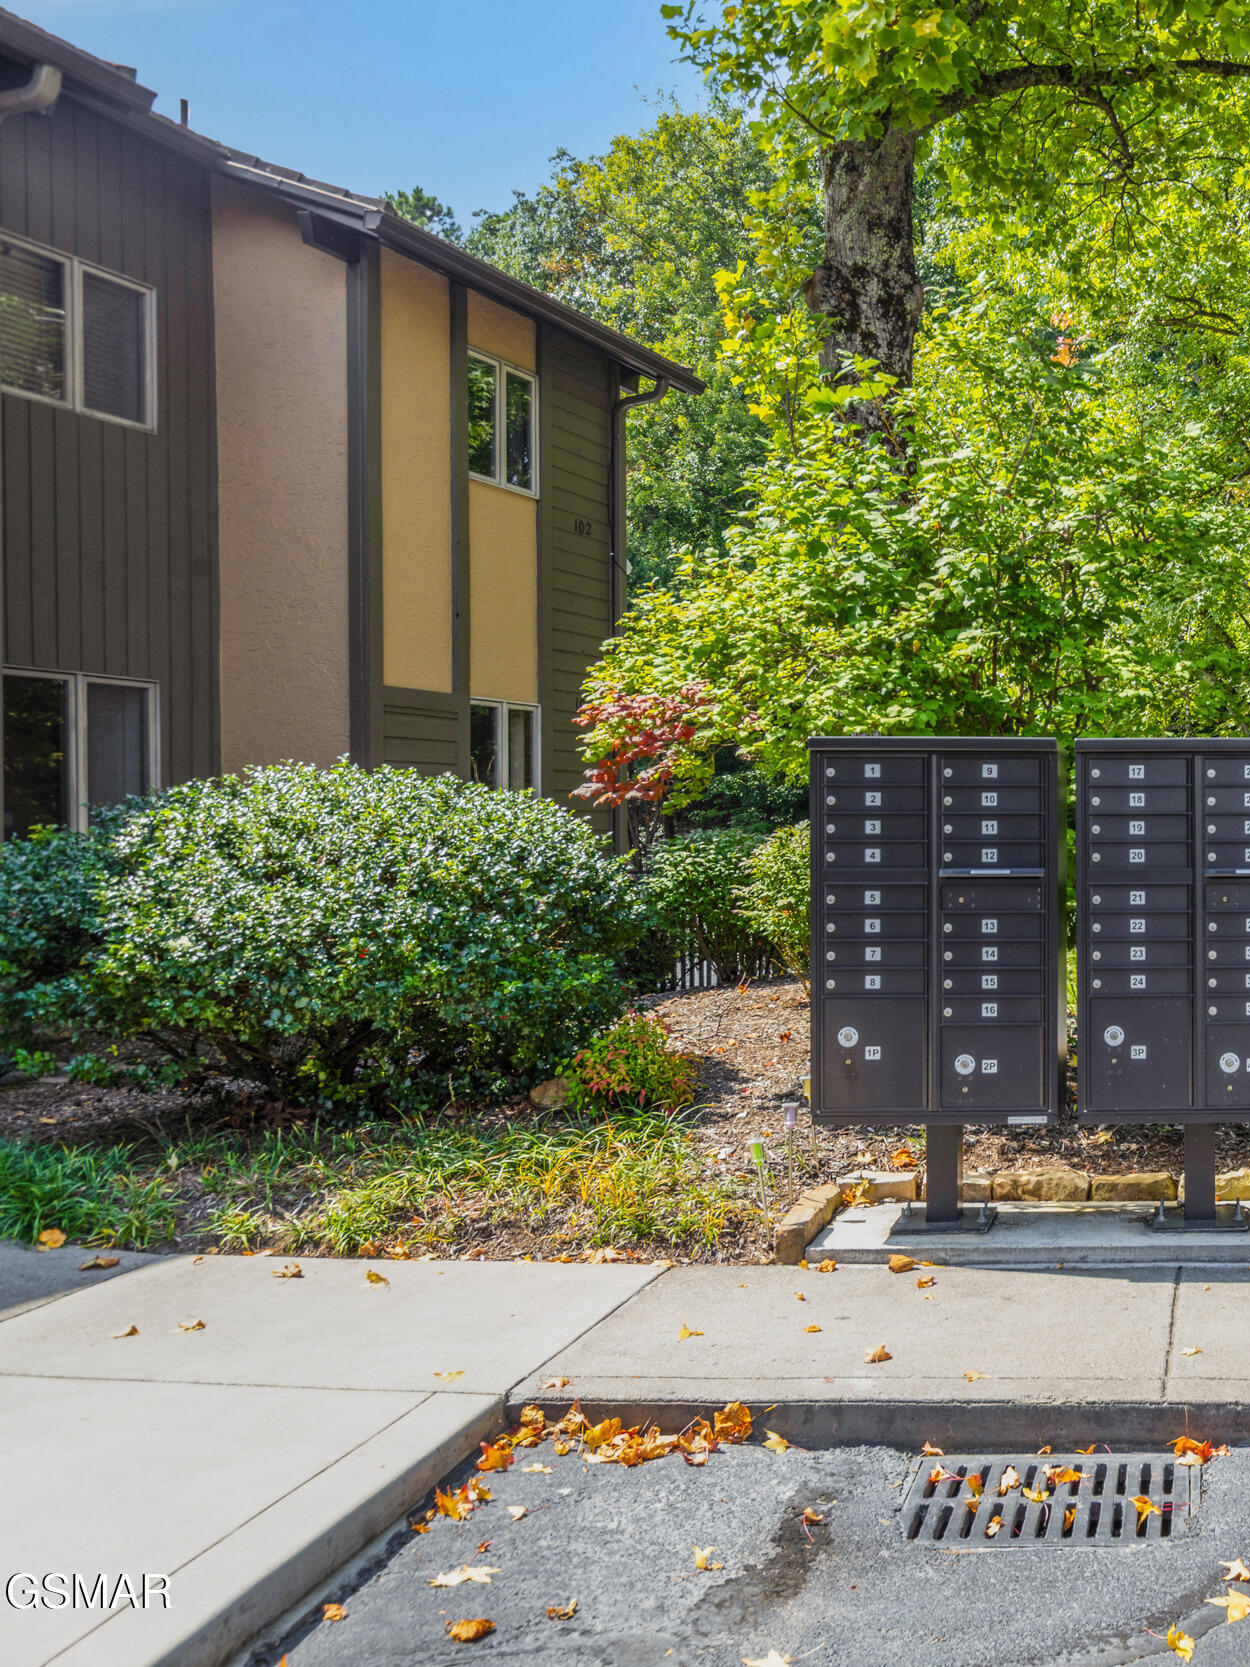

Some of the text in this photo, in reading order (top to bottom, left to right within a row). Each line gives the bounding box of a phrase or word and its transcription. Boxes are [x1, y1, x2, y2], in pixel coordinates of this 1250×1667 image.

[574, 518, 592, 535] 102
[870, 766, 875, 775] 1
[986, 766, 993, 776] 9
[1131, 767, 1142, 776] 17
[870, 794, 877, 804] 2
[984, 795, 996, 804] 10
[1131, 795, 1143, 804] 18
[870, 822, 877, 832] 3
[984, 823, 995, 832] 11
[1132, 823, 1143, 832] 19
[869, 851, 876, 860] 4
[984, 851, 996, 860] 12
[1131, 851, 1143, 860] 20
[869, 893, 876, 903] 5
[1131, 893, 1142, 902] 21
[869, 921, 876, 931] 6
[983, 921, 996, 931] 13
[1131, 921, 1143, 930] 22
[870, 949, 877, 959] 7
[984, 949, 996, 958] 14
[1132, 949, 1144, 958] 23
[869, 977, 876, 987] 8
[984, 977, 996, 987] 15
[1132, 977, 1144, 986] 24
[984, 1005, 996, 1015] 16
[867, 1048, 880, 1057] 1P
[1132, 1048, 1145, 1057] 3P
[983, 1062, 996, 1071] 2P
